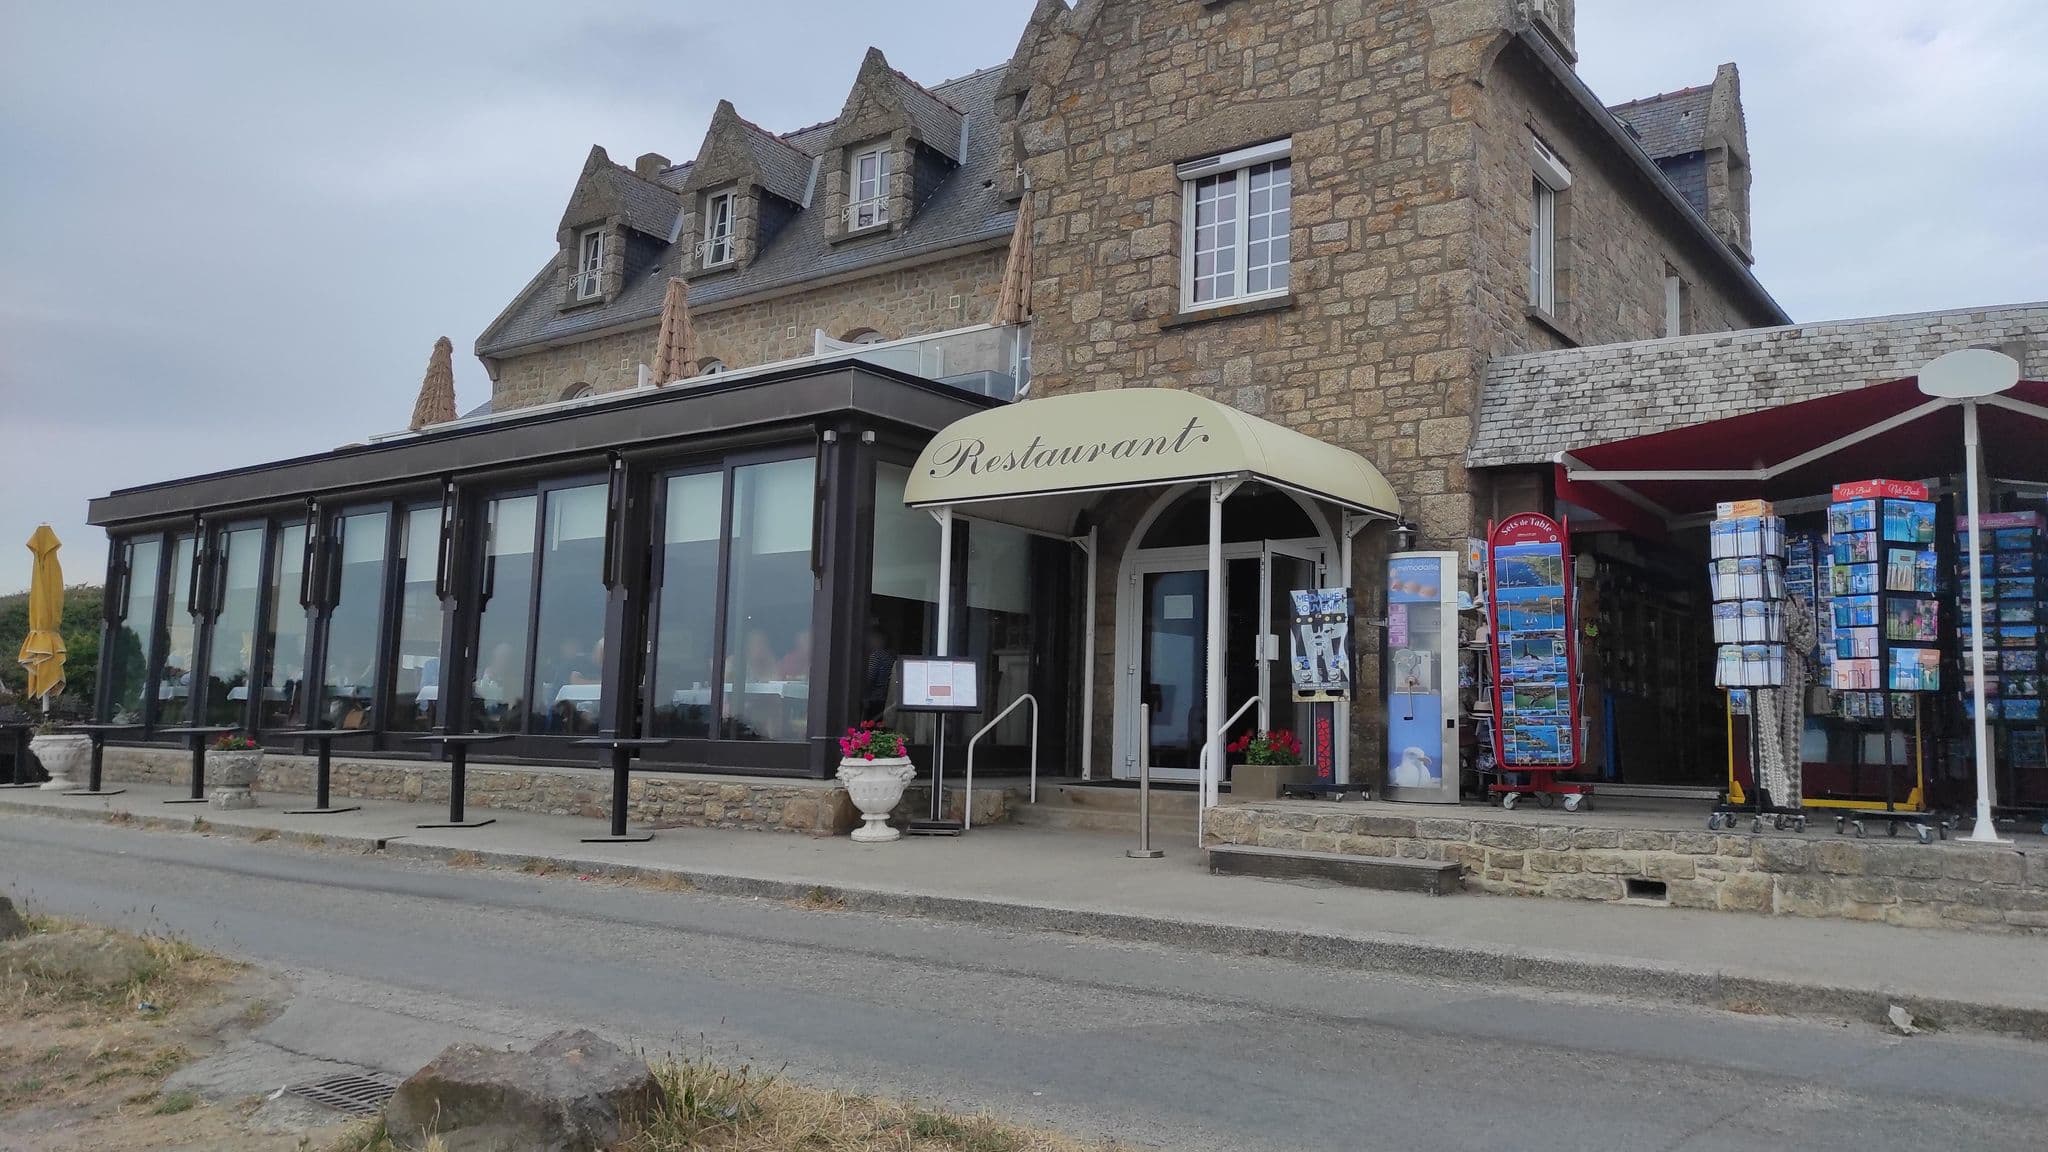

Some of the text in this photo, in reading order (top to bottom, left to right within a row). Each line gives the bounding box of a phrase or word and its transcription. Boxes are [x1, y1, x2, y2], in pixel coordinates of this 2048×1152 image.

[929, 416, 1209, 479] Restaurant
[1501, 521, 1519, 536] Sets
[1530, 517, 1552, 532] Table
[1296, 603, 1341, 613] SOUVENIR
